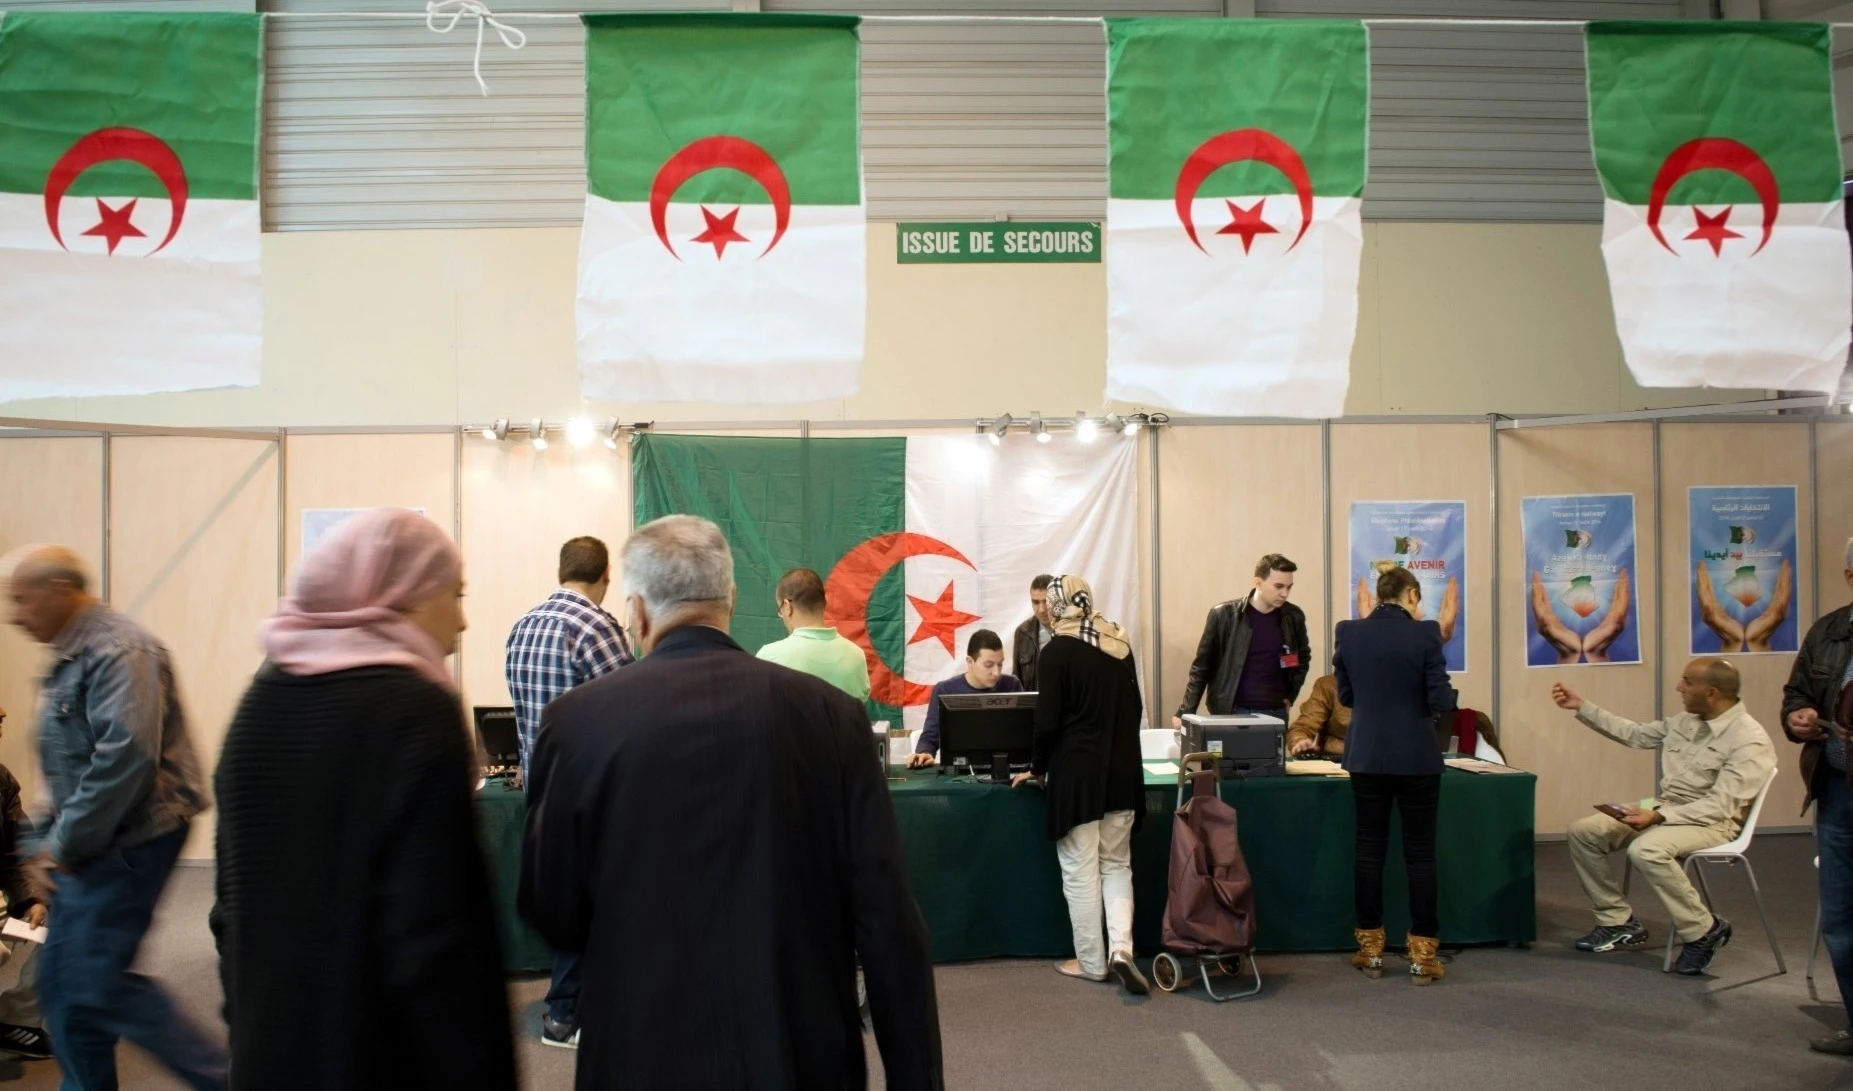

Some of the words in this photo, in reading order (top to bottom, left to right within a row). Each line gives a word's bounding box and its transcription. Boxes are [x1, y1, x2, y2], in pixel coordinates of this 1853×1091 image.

[903, 231, 960, 254] ISSUE
[970, 231, 994, 253] DE
[1004, 231, 1093, 253] SECOURS
[1407, 560, 1445, 570] AVENIR
[986, 697, 1013, 706] acer
